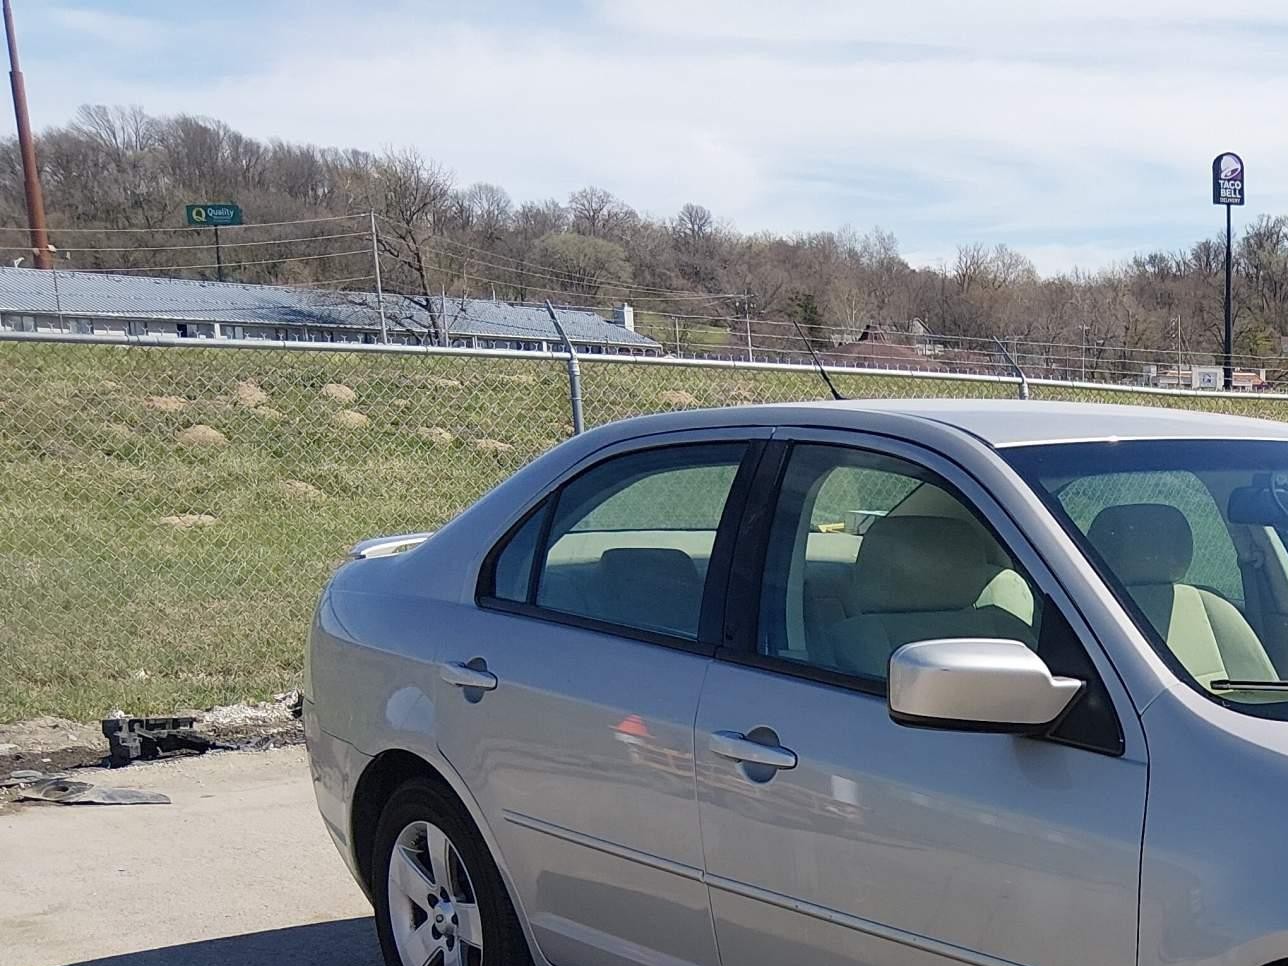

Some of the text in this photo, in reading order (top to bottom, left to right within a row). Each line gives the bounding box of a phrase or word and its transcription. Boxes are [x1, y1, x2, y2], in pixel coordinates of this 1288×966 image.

[1219, 180, 1242, 189] TACO
[1220, 189, 1242, 198] BELL
[207, 207, 234, 218] Quality
